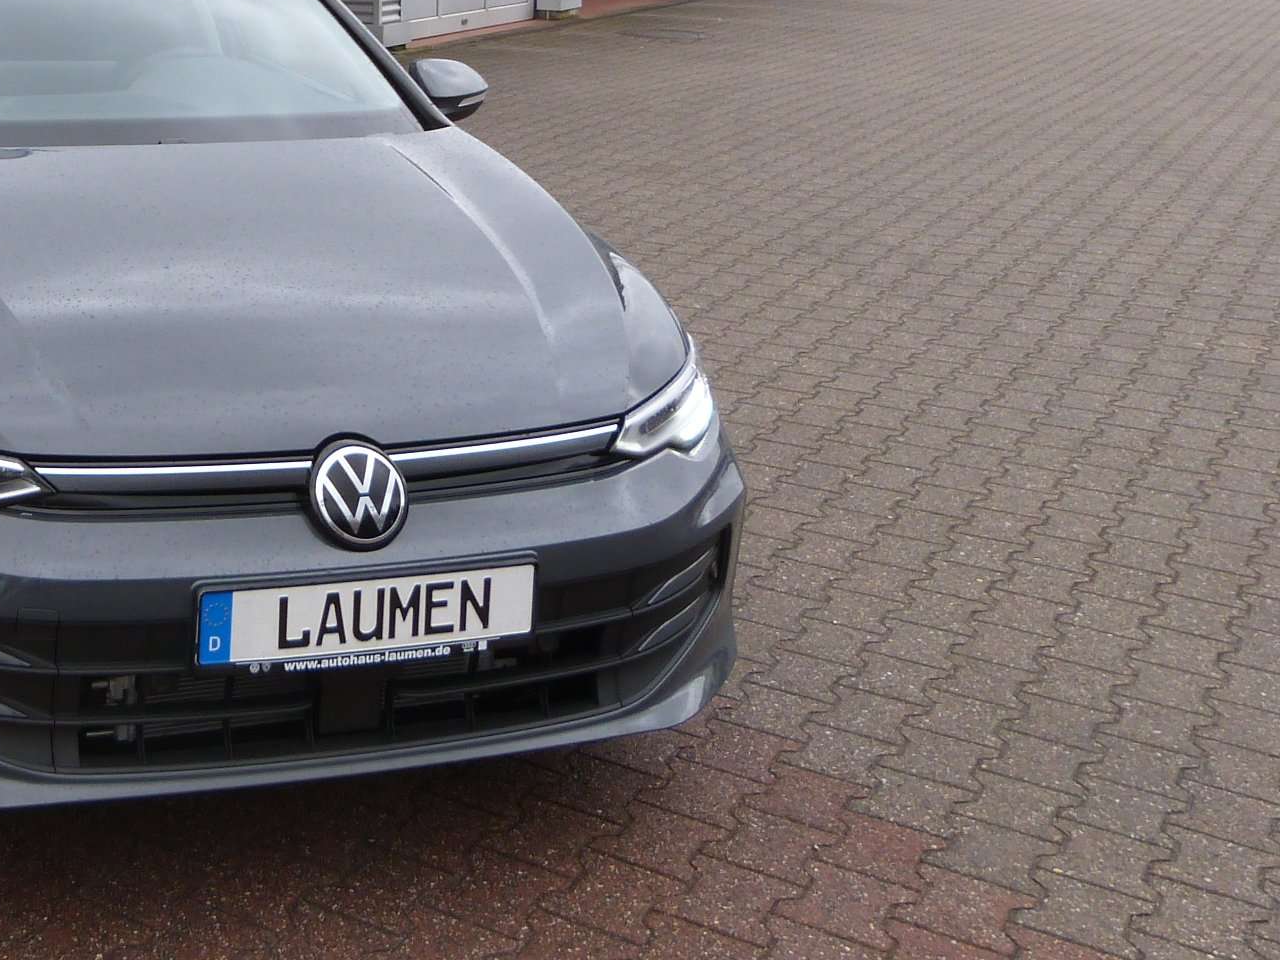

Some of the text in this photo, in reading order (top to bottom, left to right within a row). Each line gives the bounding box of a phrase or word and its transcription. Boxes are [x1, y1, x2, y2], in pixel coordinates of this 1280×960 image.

[277, 577, 492, 649] LAUMEN
[208, 636, 221, 652] D
[284, 646, 451, 672] www.autohaus-laumen.de
